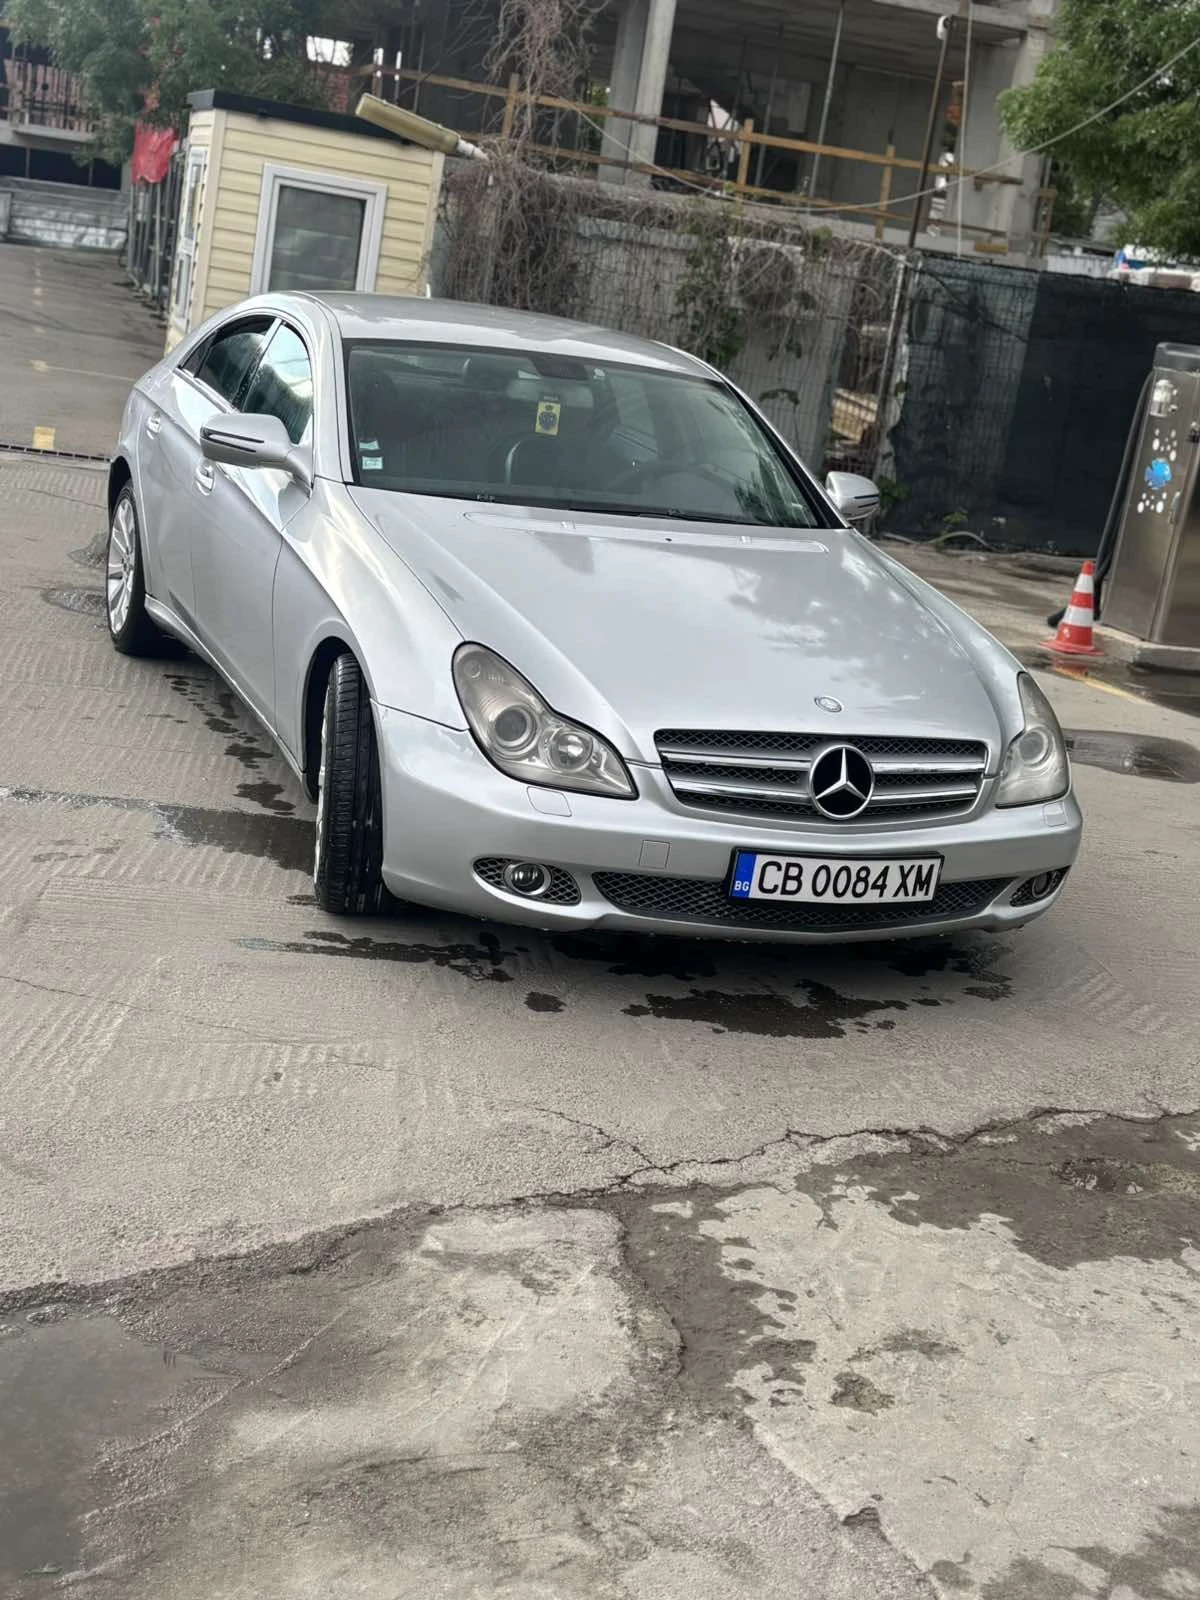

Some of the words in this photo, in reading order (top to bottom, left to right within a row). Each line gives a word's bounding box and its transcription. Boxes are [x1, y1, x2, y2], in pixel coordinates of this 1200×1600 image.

[734, 880, 749, 891] BG
[758, 861, 803, 896] CB
[811, 864, 890, 898] 0084
[893, 864, 935, 897] XM
